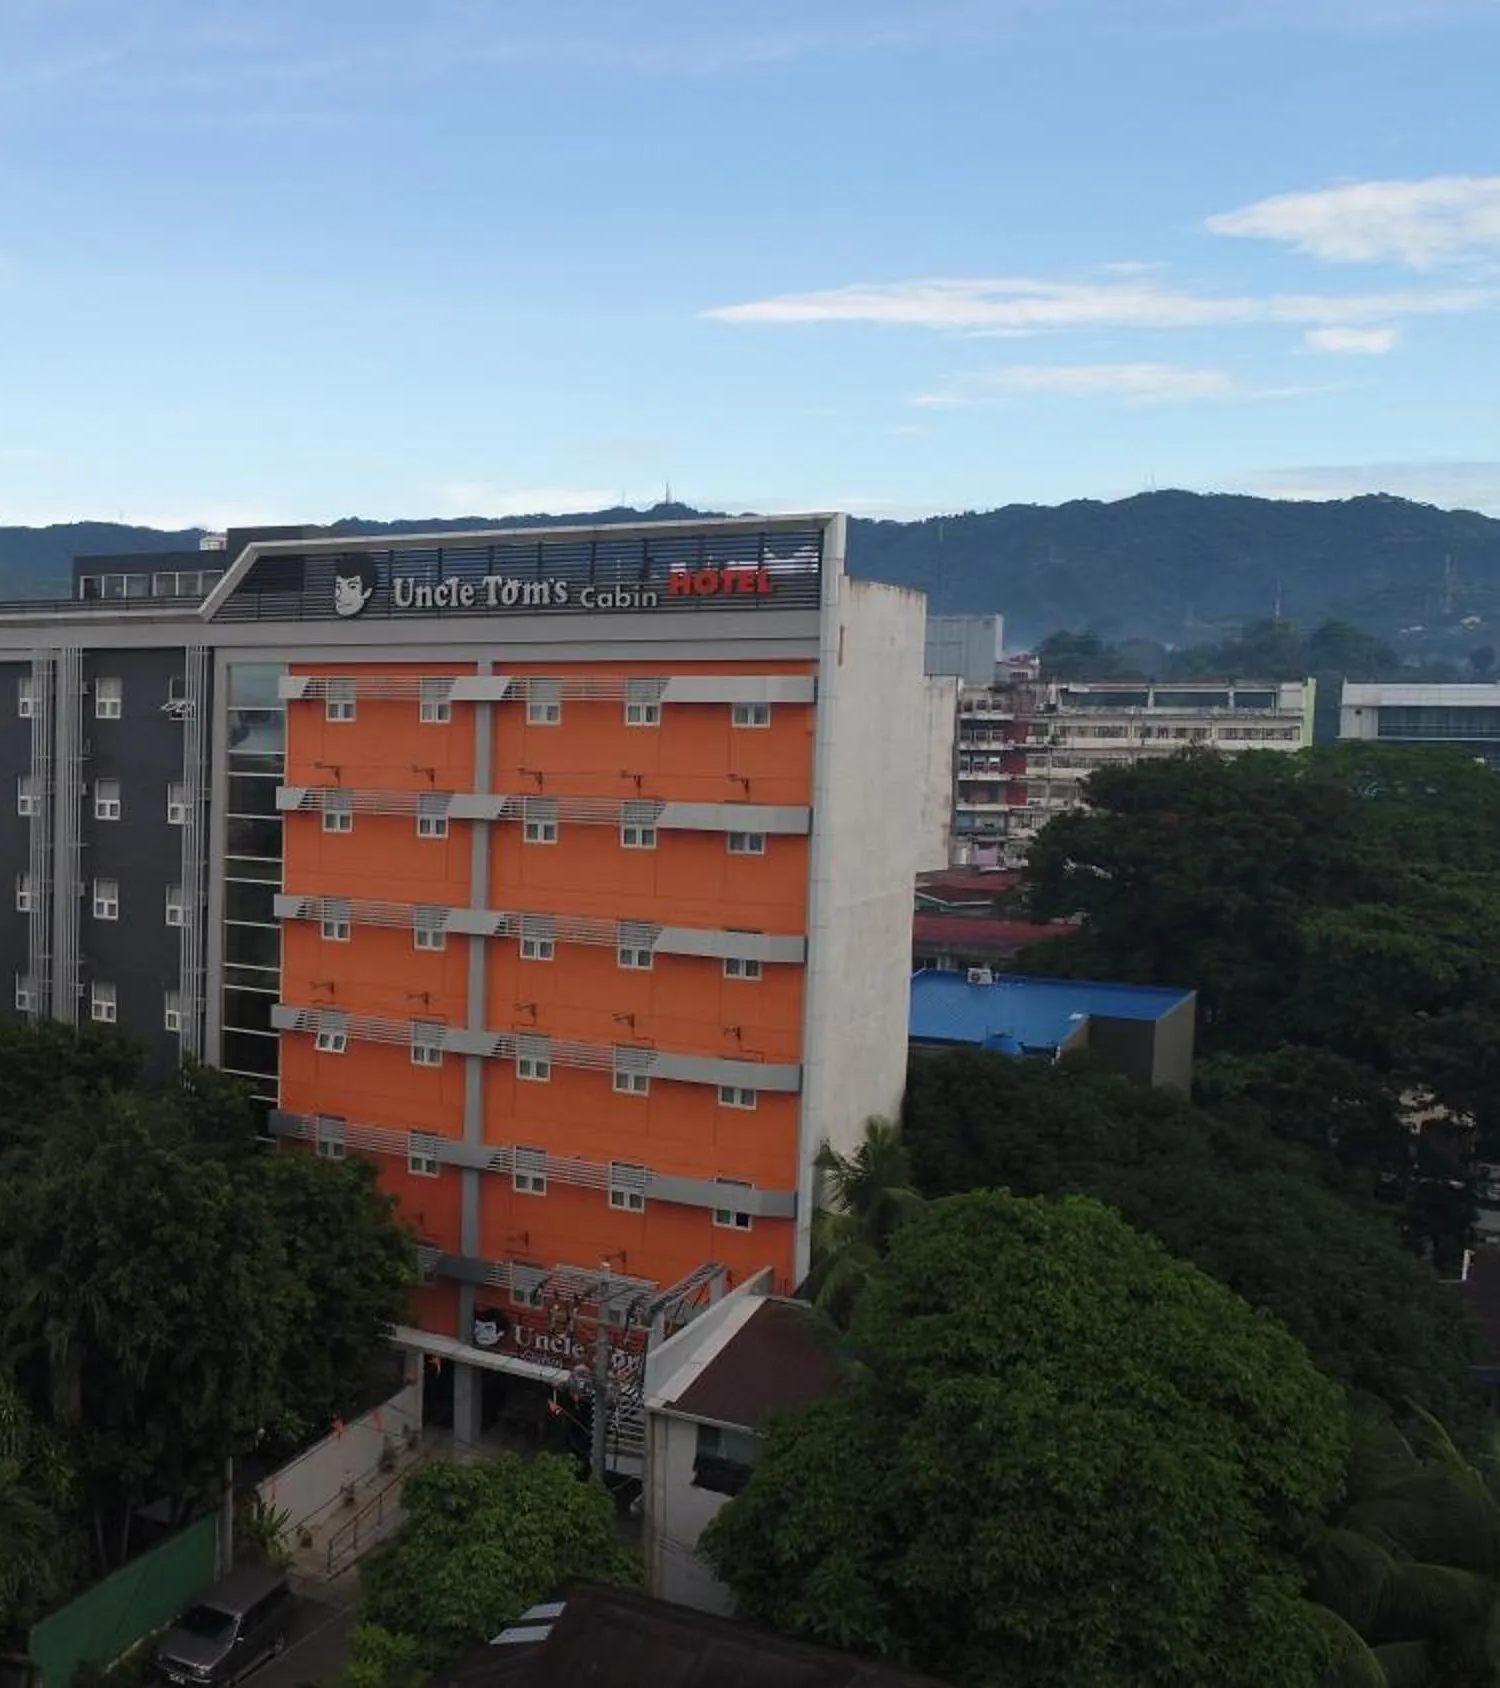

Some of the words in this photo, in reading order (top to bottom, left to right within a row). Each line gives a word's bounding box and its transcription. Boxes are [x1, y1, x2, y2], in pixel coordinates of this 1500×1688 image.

[393, 577, 475, 607] Uncle
[482, 575, 569, 606] Tom's
[580, 585, 658, 608] Cabin
[669, 570, 772, 595] HOTEL
[515, 1325, 585, 1358] Uncle
